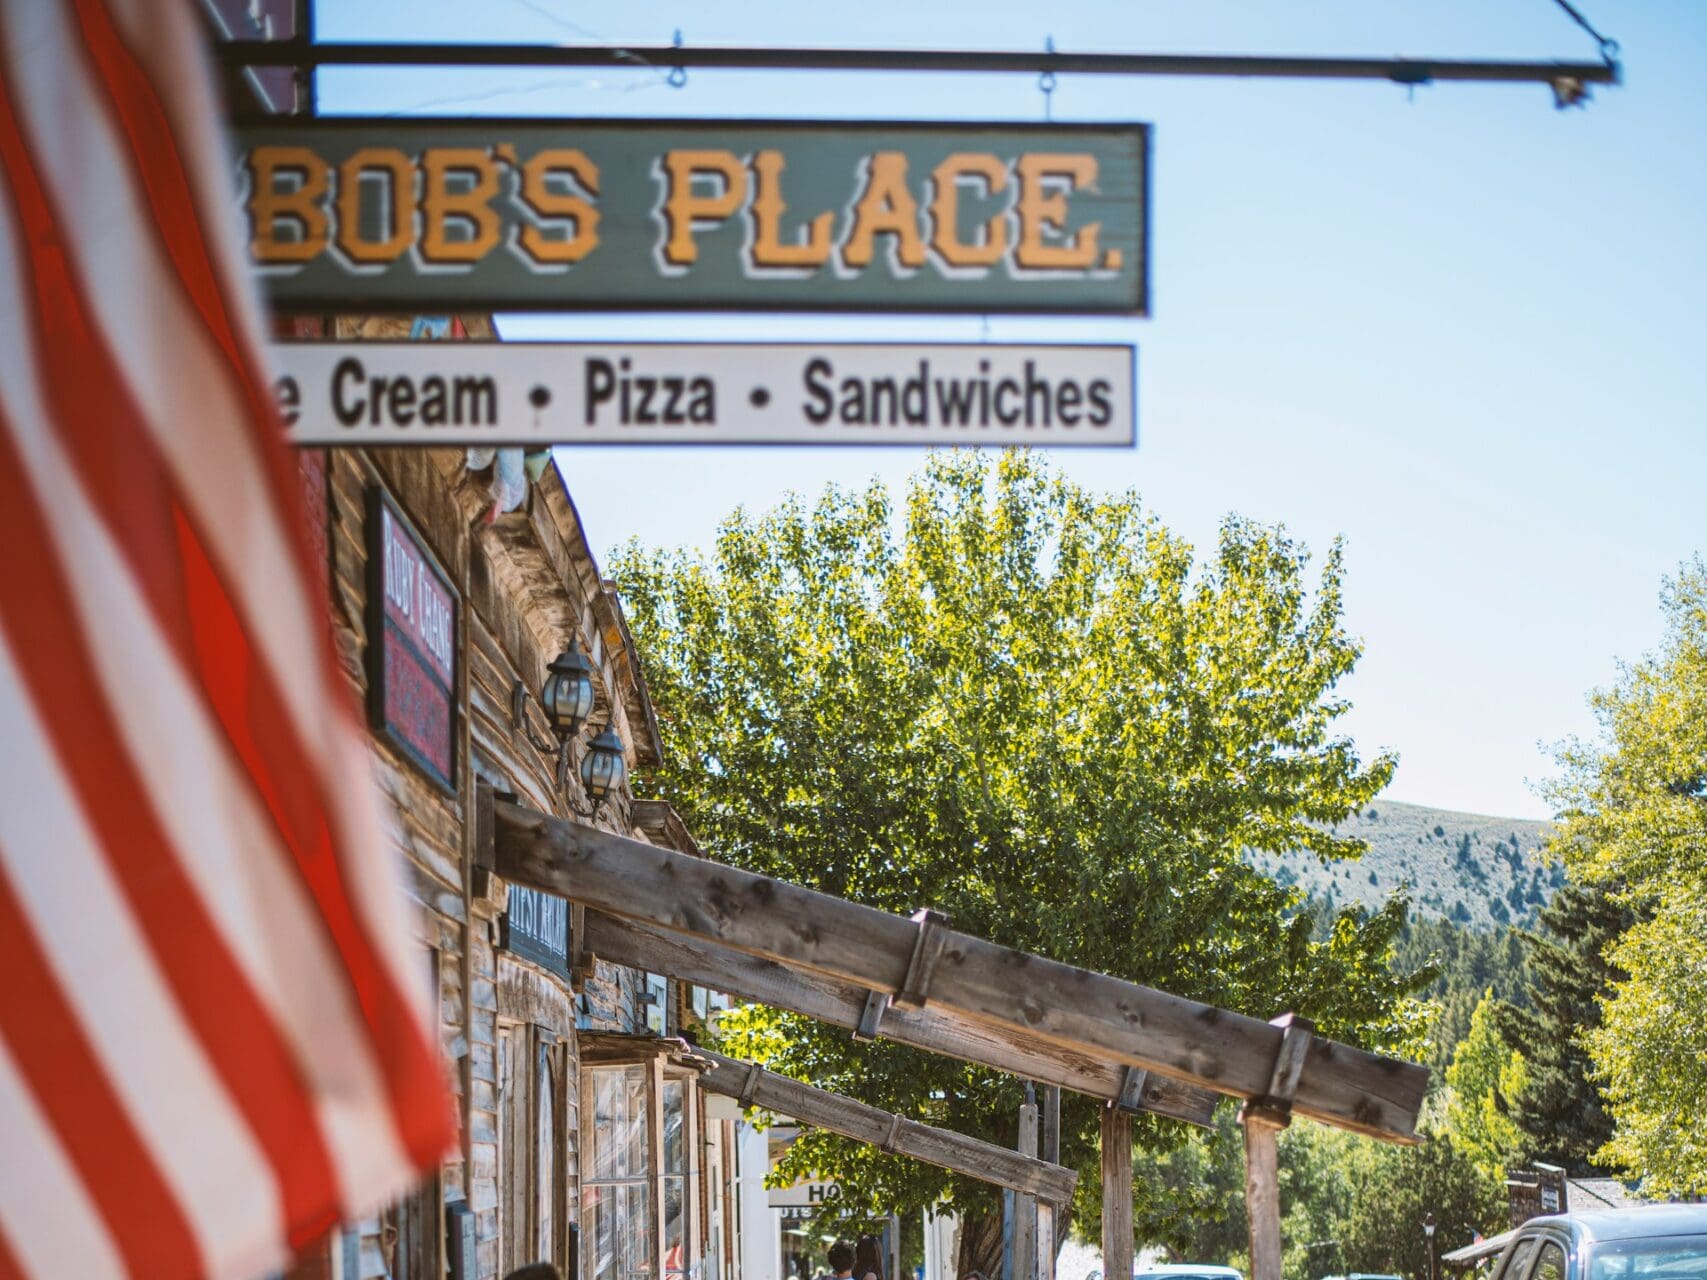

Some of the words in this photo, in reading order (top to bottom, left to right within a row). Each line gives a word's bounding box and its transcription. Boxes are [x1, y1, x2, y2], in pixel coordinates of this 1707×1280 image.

[246, 142, 600, 274] BOB'S
[330, 356, 498, 429] Cream
[584, 356, 717, 426] Pizza
[803, 356, 1112, 428] Sandwiches
